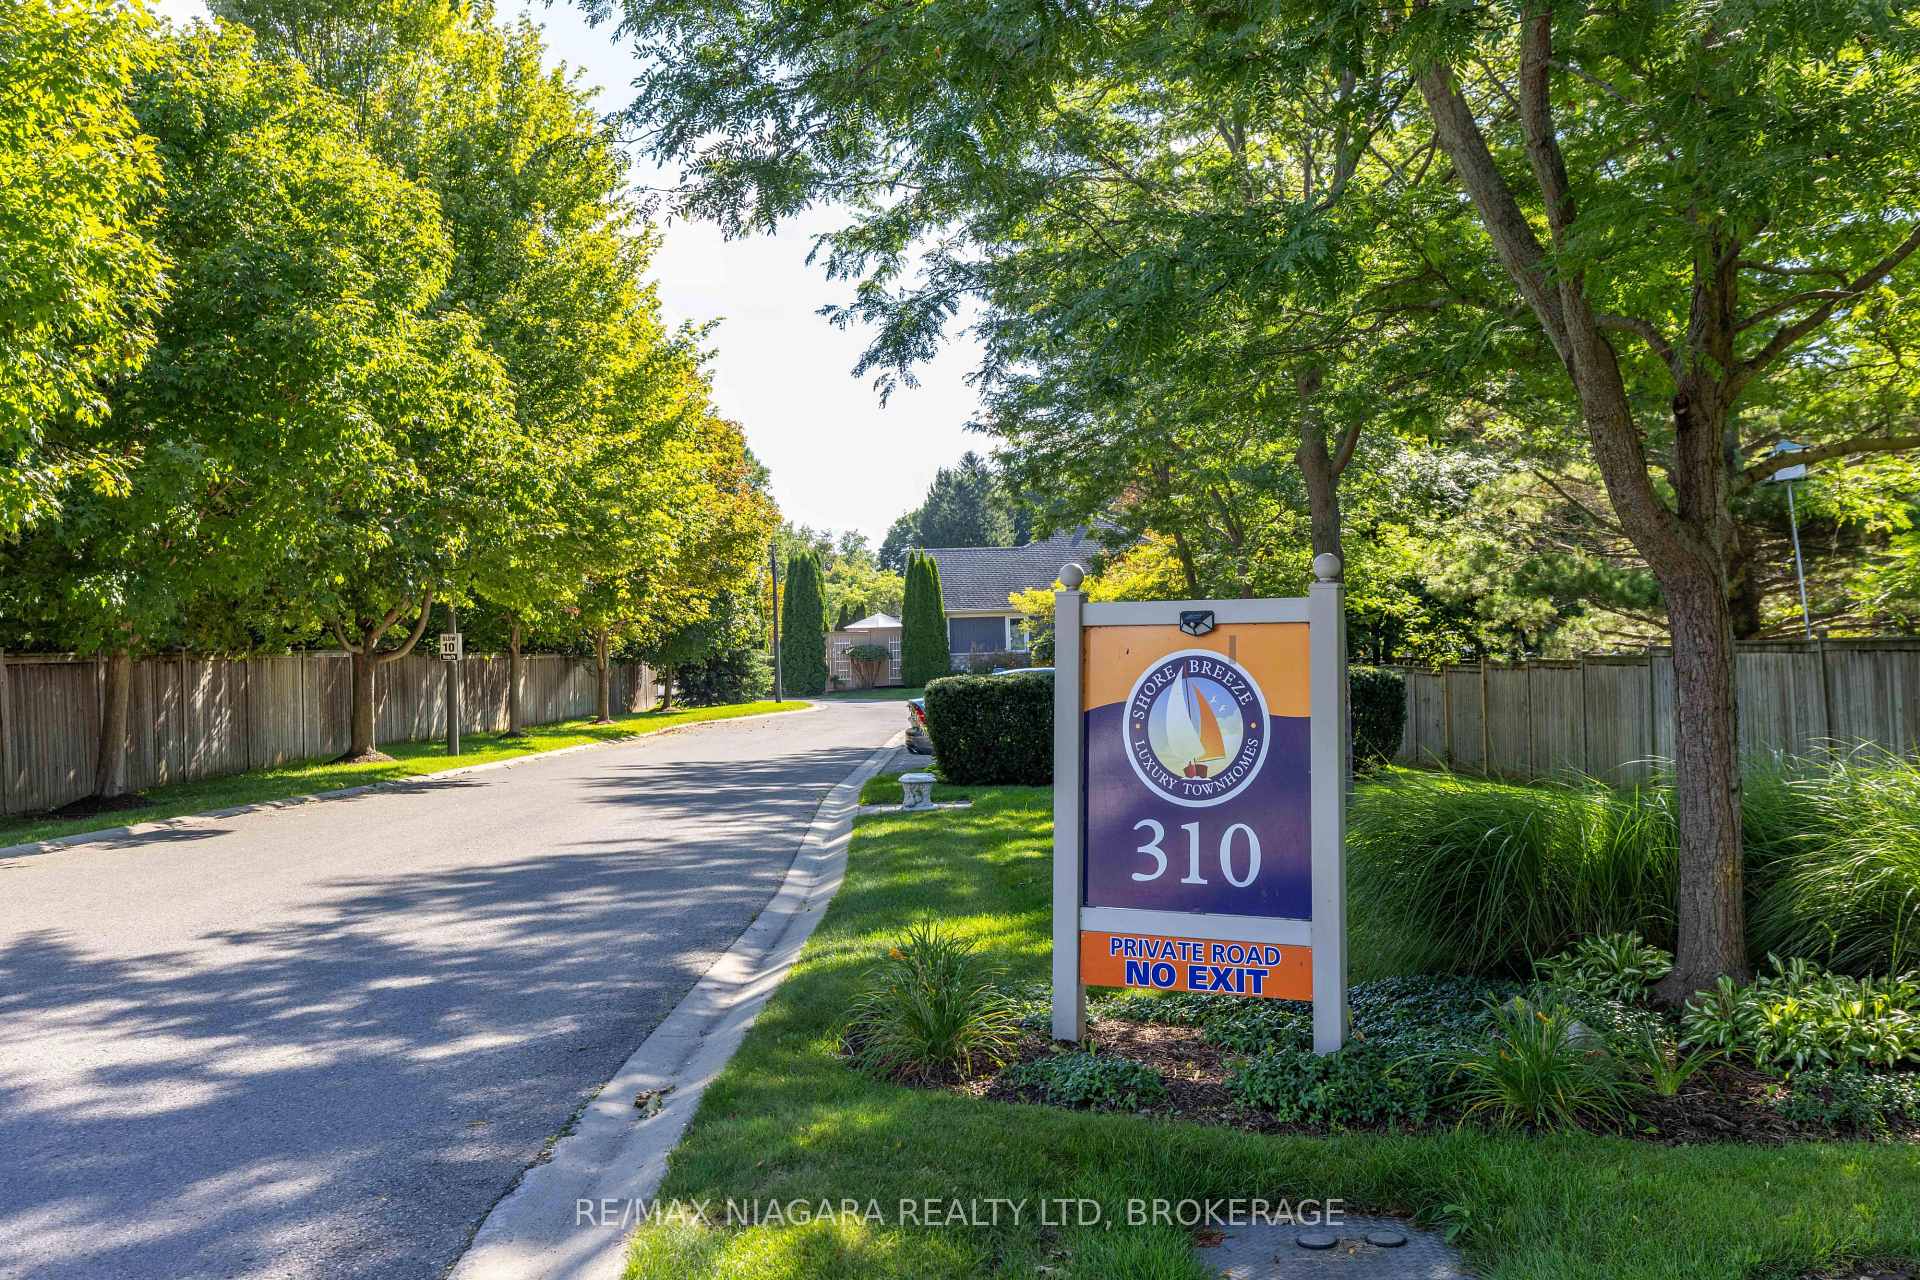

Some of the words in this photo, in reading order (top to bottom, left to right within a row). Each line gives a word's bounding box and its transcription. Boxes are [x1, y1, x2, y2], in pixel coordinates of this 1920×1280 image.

[443, 642, 455, 652] 10
[1133, 665, 1176, 720] SHORE
[1189, 659, 1252, 706] BREEZE
[1135, 740, 1178, 790] LUXURY
[1183, 738, 1258, 796] TOWNHOMES
[1131, 818, 1262, 888] 310
[1109, 936, 1205, 963] PRIVATE
[1211, 943, 1281, 967] ROAD
[1125, 959, 1178, 989] NO
[1188, 964, 1269, 995] EXIT
